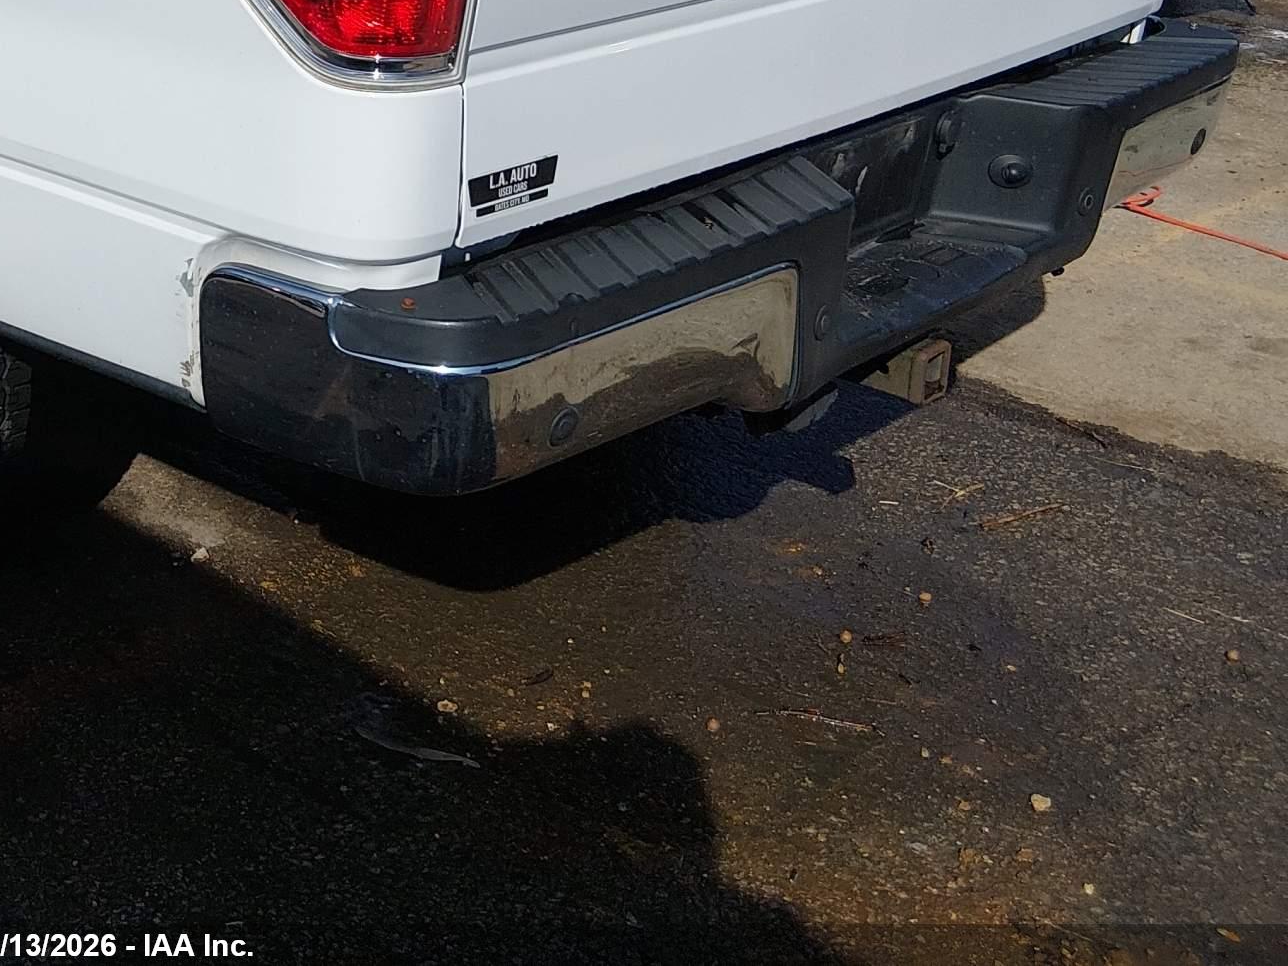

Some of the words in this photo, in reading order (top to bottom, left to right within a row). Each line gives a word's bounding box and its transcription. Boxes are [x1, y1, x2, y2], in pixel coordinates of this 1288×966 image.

[489, 172, 509, 189] L.A.
[510, 163, 537, 184] AUTO
[498, 185, 513, 198] USED
[513, 181, 528, 193] CARS
